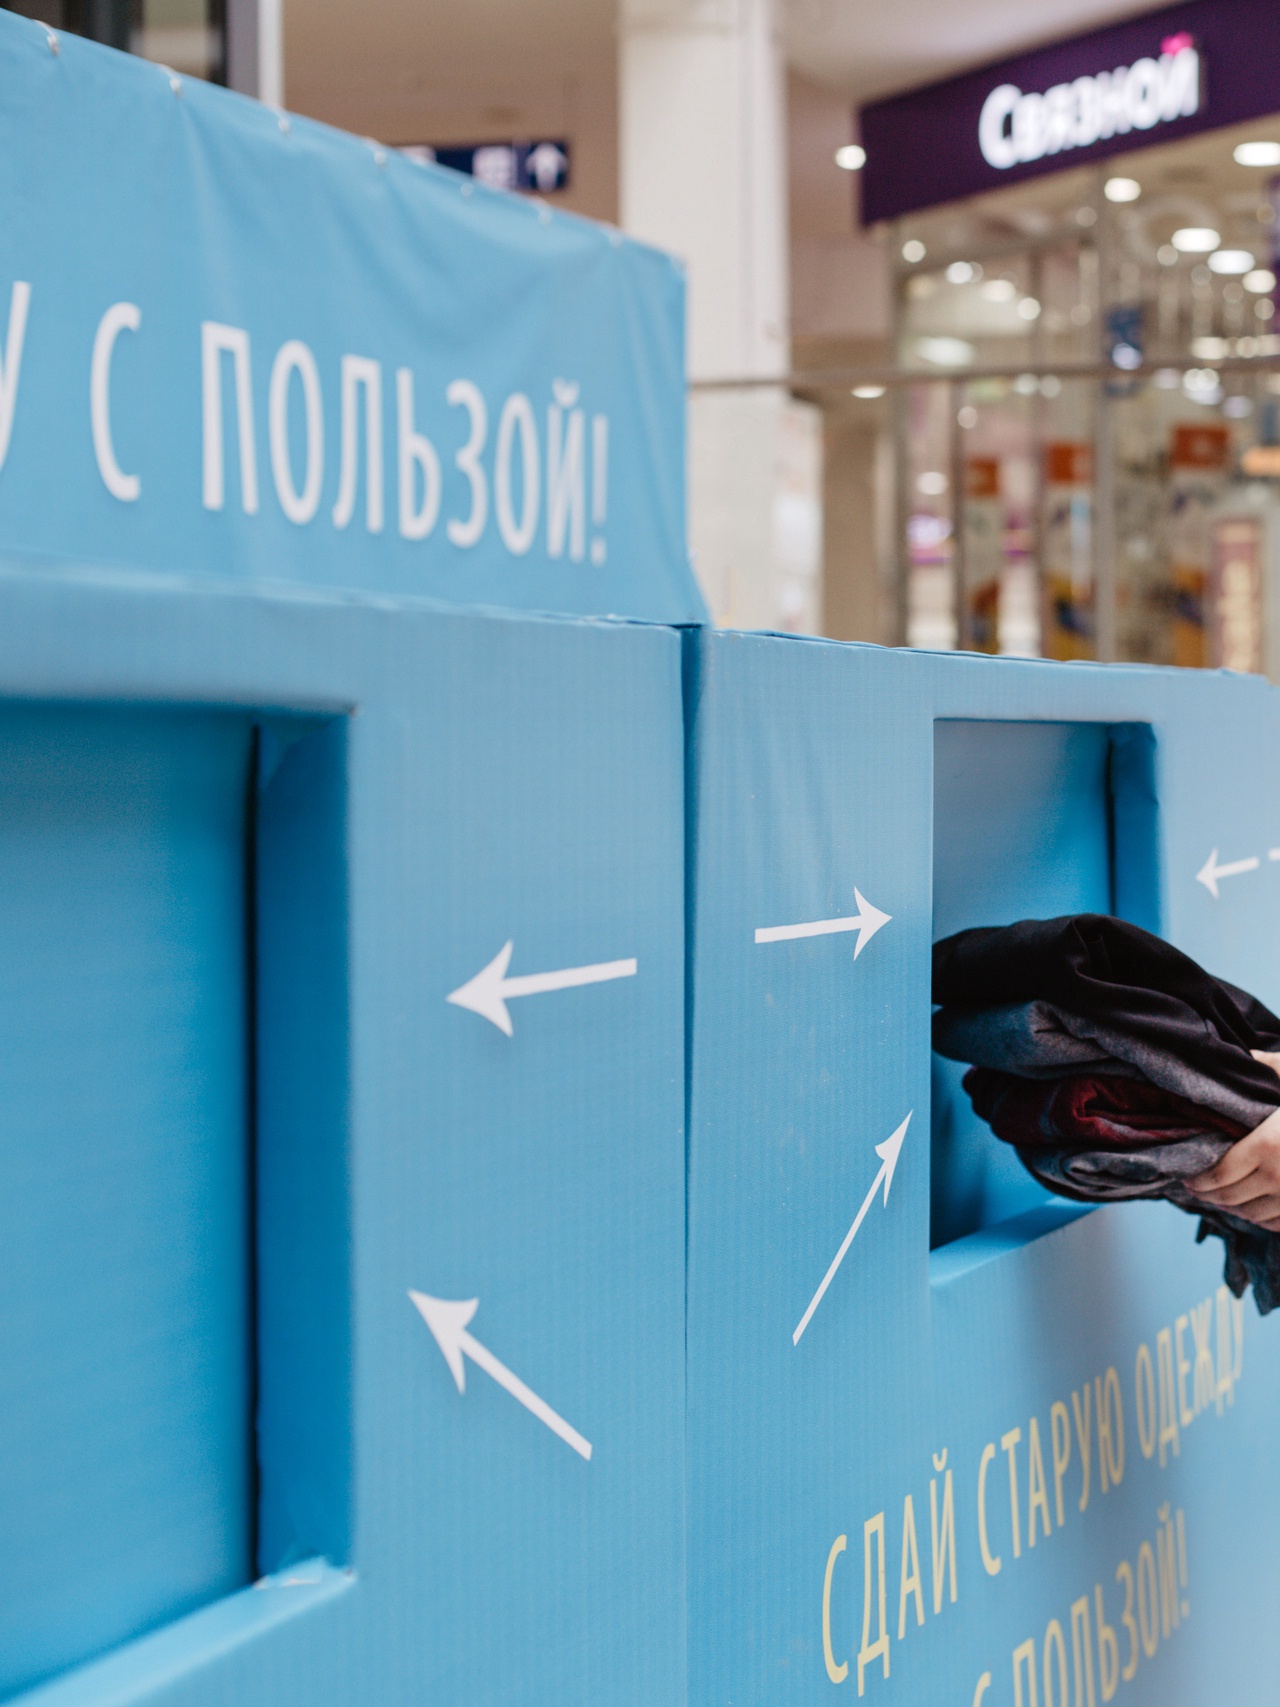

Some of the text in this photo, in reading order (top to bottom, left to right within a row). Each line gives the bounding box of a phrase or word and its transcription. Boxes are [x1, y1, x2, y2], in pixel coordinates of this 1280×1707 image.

[90, 301, 142, 503] С
[201, 320, 609, 568] ПОЛЬЗОЙ!
[822, 1447, 958, 1698] СДАЙ
[977, 1366, 1125, 1577] СТАРУЮ
